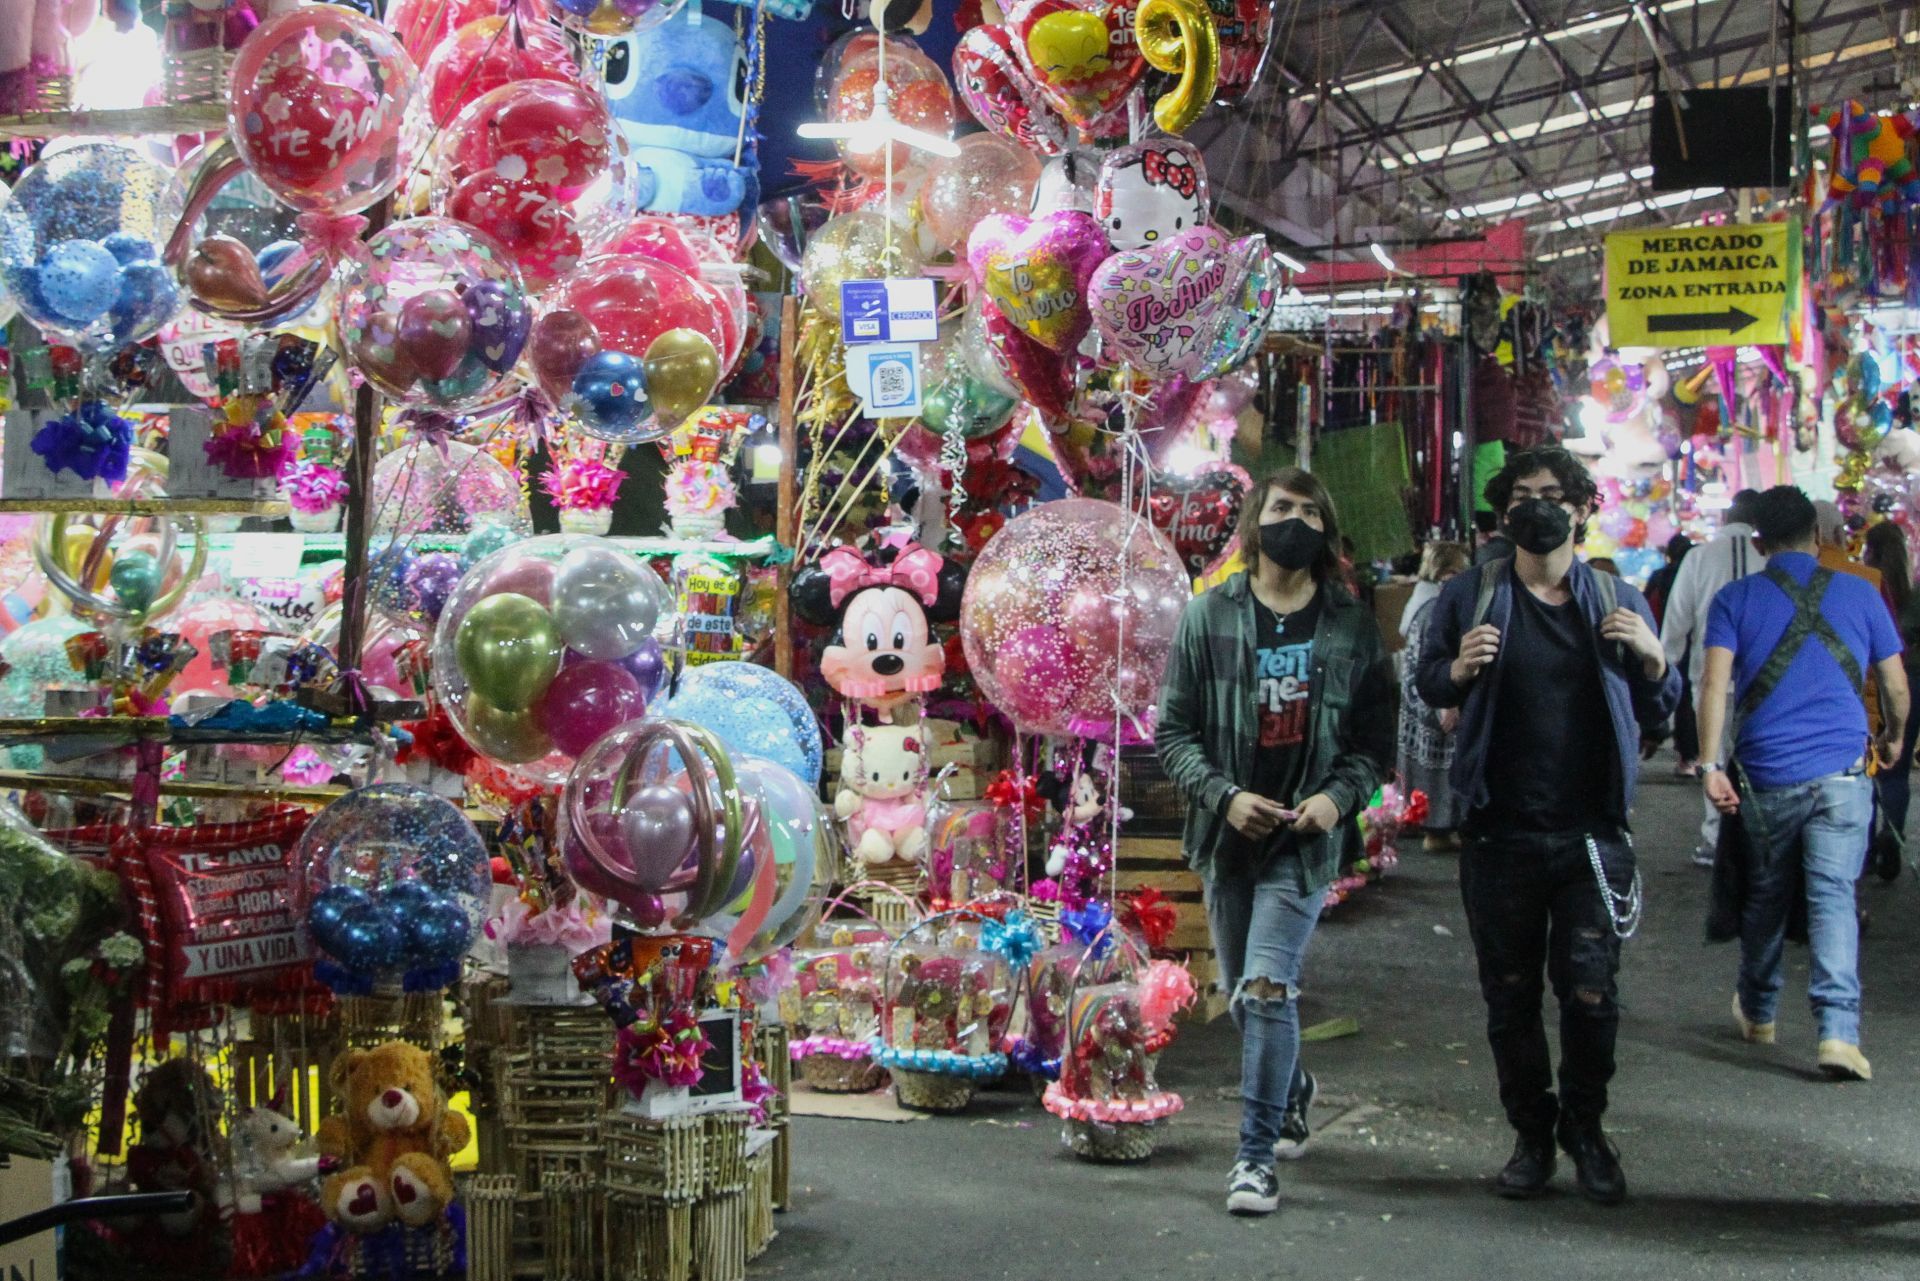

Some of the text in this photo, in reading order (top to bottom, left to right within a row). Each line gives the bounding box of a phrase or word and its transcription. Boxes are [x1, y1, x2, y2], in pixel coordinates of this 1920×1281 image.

[268, 127, 310, 156] TE
[1643, 233, 1764, 254] MERCADO
[1627, 253, 1779, 275] DE JAMAICA
[995, 259, 1034, 296] Te
[1126, 261, 1227, 333] Te Amo
[1618, 280, 1787, 300] ZONA ENTRADA
[858, 323, 877, 331] VISA
[689, 578, 710, 592] Hoy
[687, 616, 732, 631] de este
[179, 844, 282, 872] TE AMO
[200, 934, 298, 972] Y UNA VIDA
